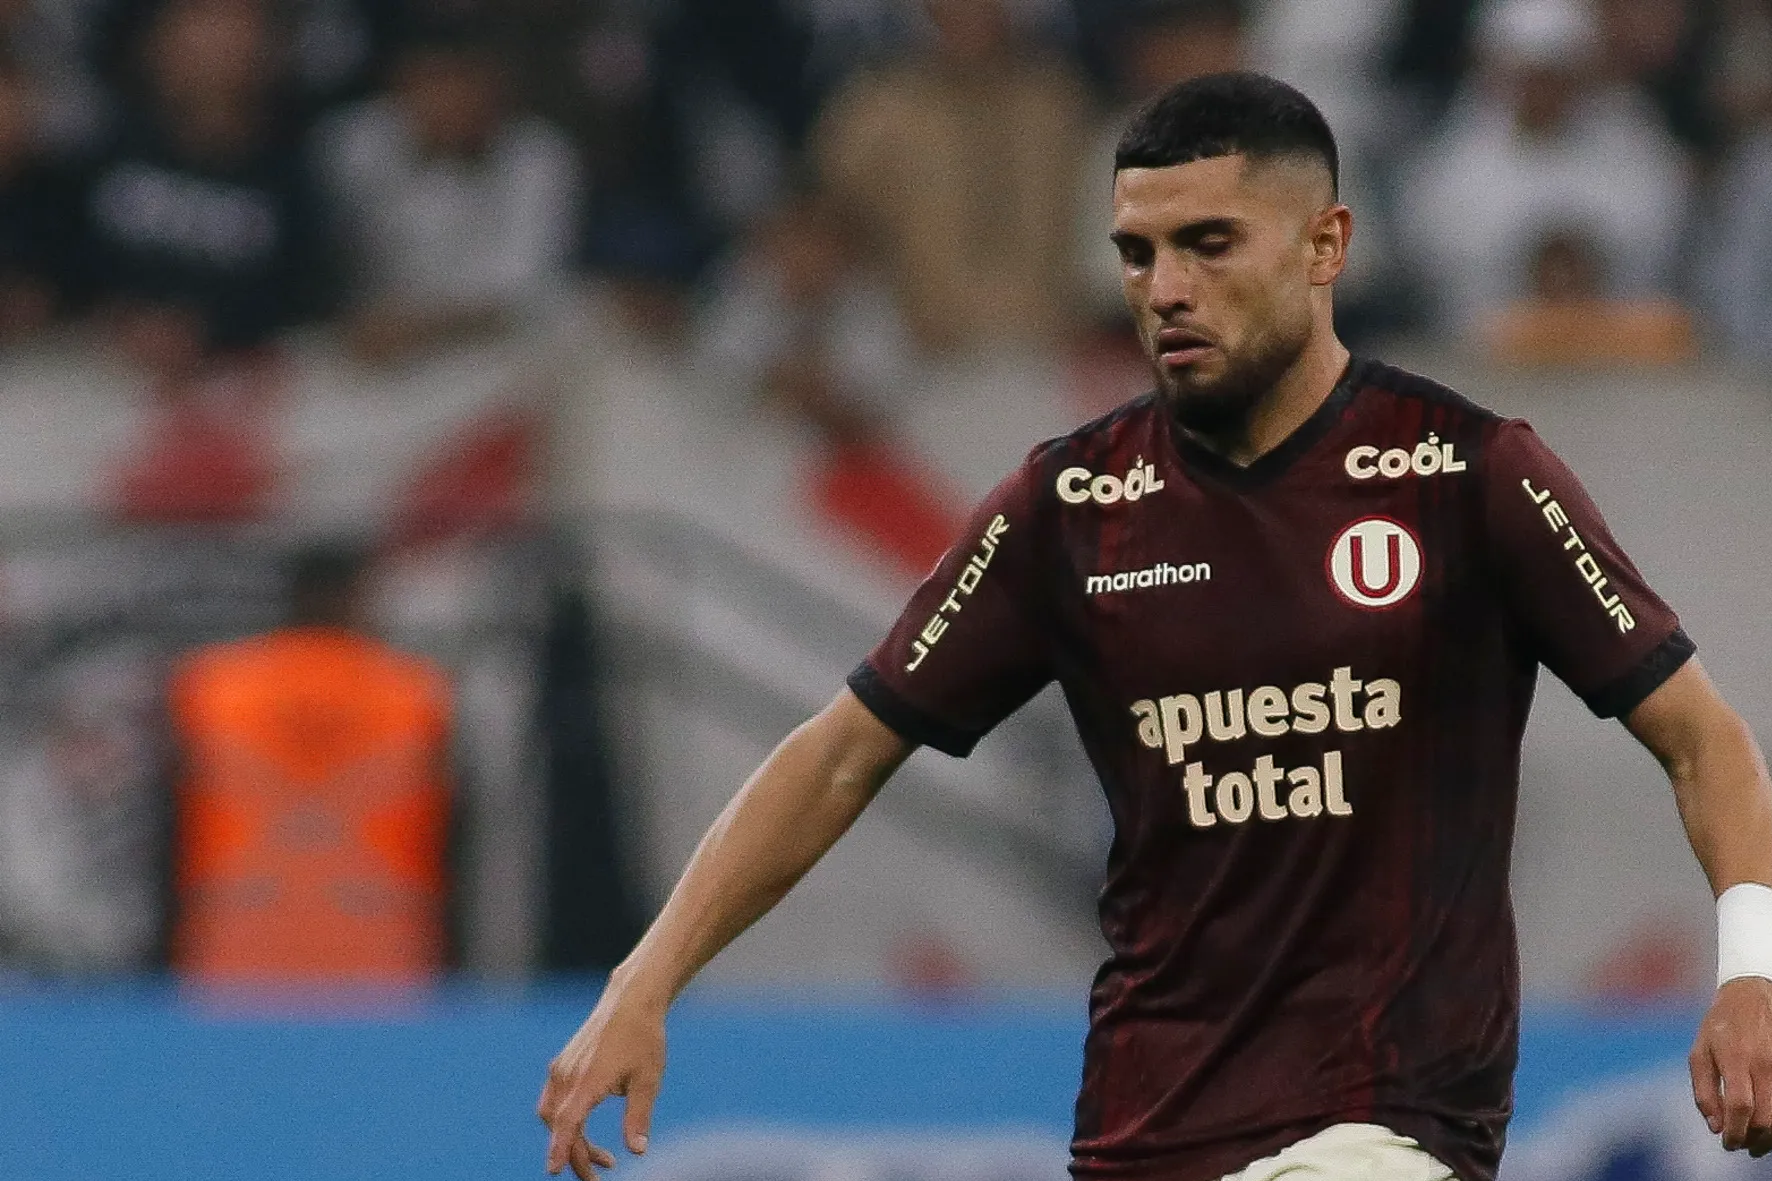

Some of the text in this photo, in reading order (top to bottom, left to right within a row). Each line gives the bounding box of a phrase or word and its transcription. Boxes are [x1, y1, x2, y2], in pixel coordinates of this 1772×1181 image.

[904, 513, 1011, 673] JETOUR
[1085, 560, 1212, 595] marathon
[1348, 532, 1403, 600] U
[1520, 476, 1637, 636] JETOUR
[1128, 664, 1403, 767] apuesta
[1182, 750, 1354, 829] total
